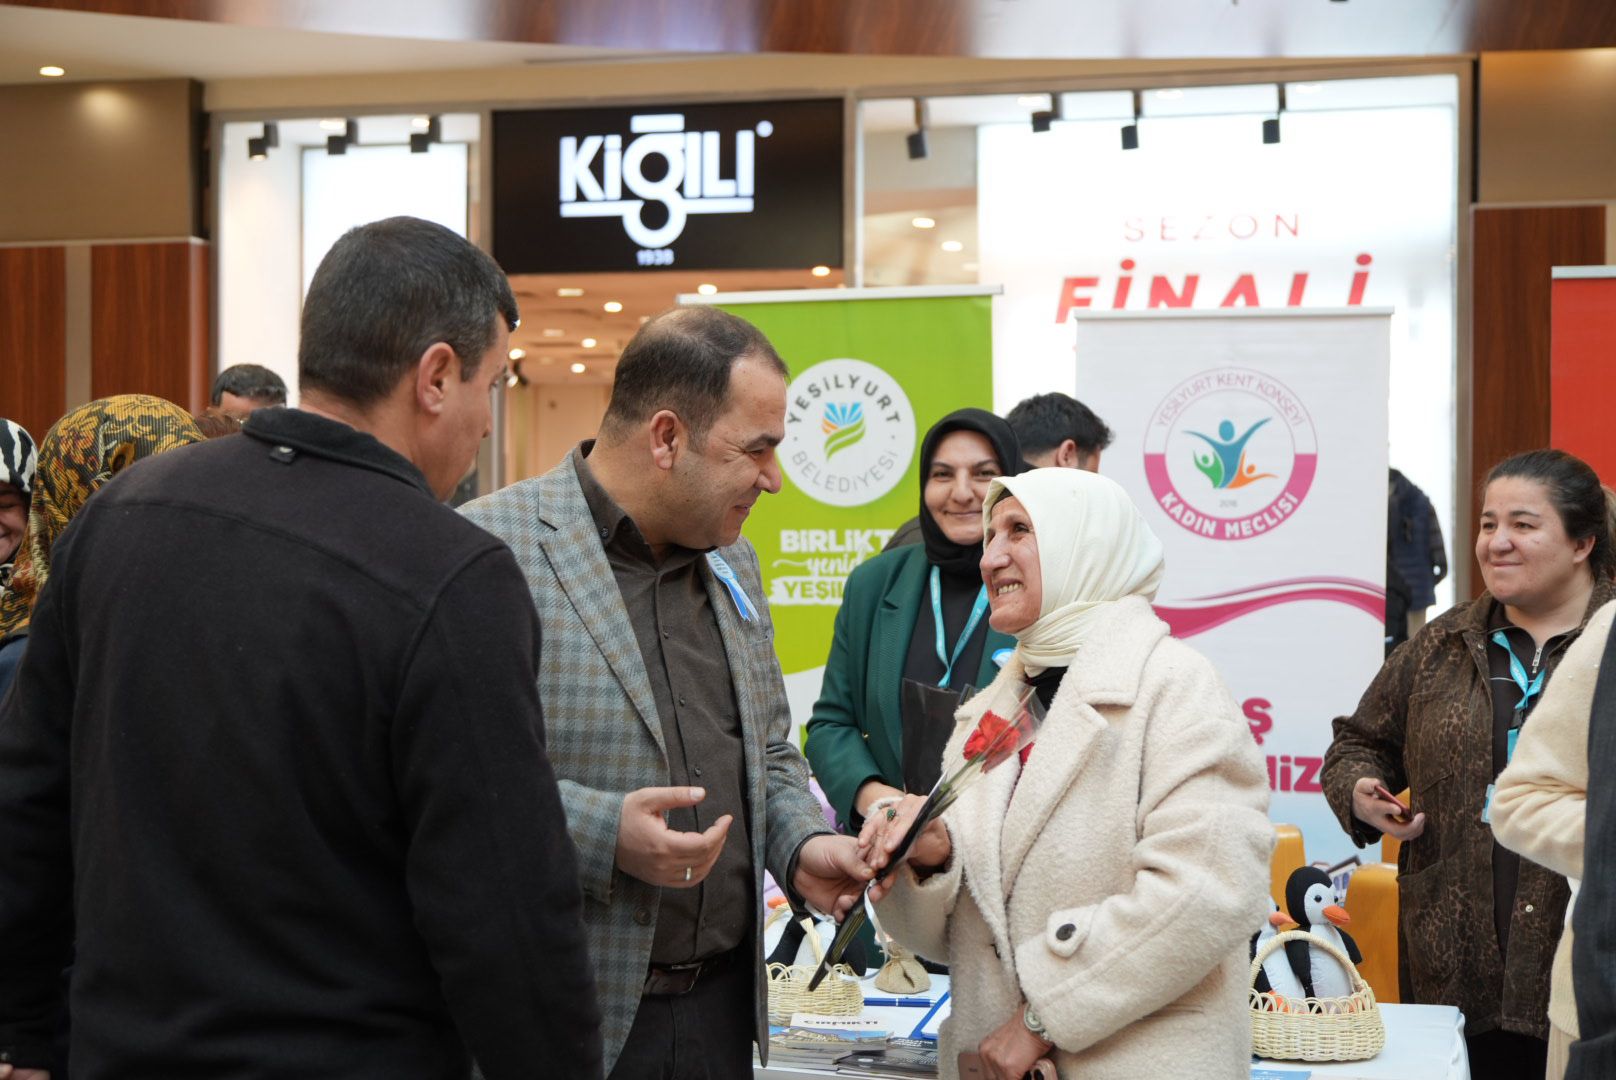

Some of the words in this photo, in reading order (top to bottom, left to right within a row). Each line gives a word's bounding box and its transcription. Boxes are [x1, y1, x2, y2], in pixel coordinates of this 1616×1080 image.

[1124, 213, 1299, 242] SEZON
[1216, 373, 1254, 387] KENT
[1161, 491, 1217, 536] KADIN
